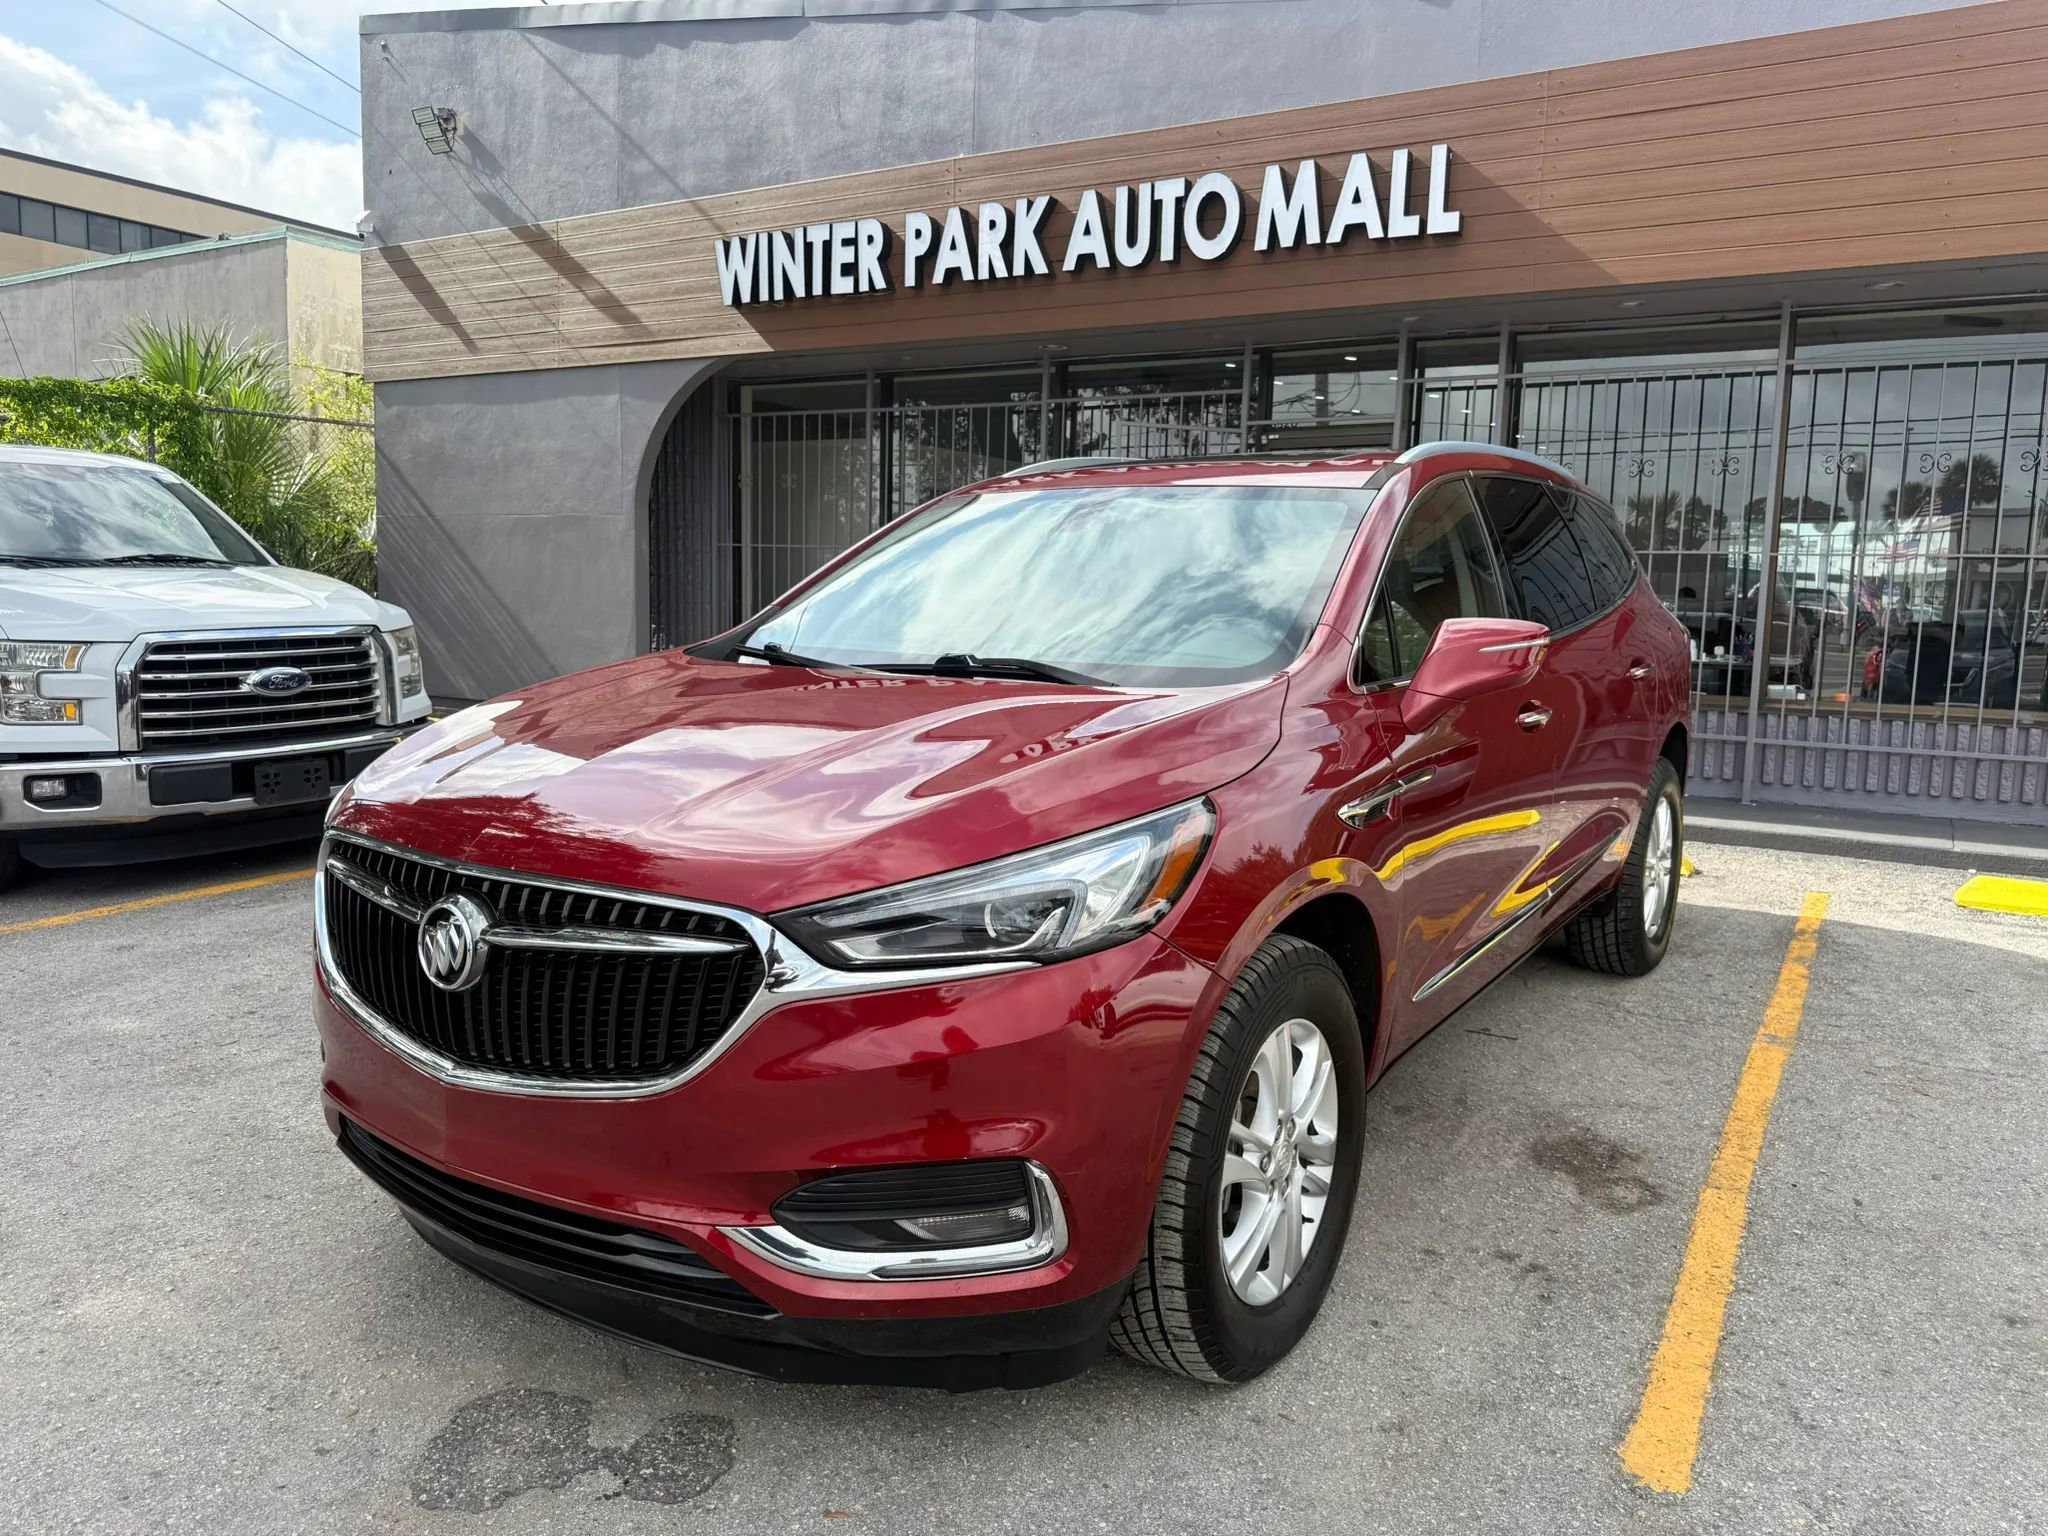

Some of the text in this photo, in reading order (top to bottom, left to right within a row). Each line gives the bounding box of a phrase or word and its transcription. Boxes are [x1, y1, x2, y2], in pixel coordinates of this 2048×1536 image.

[714, 143, 1462, 307] WINTER PARK AUTO MALL
[268, 674, 299, 689] Ford
